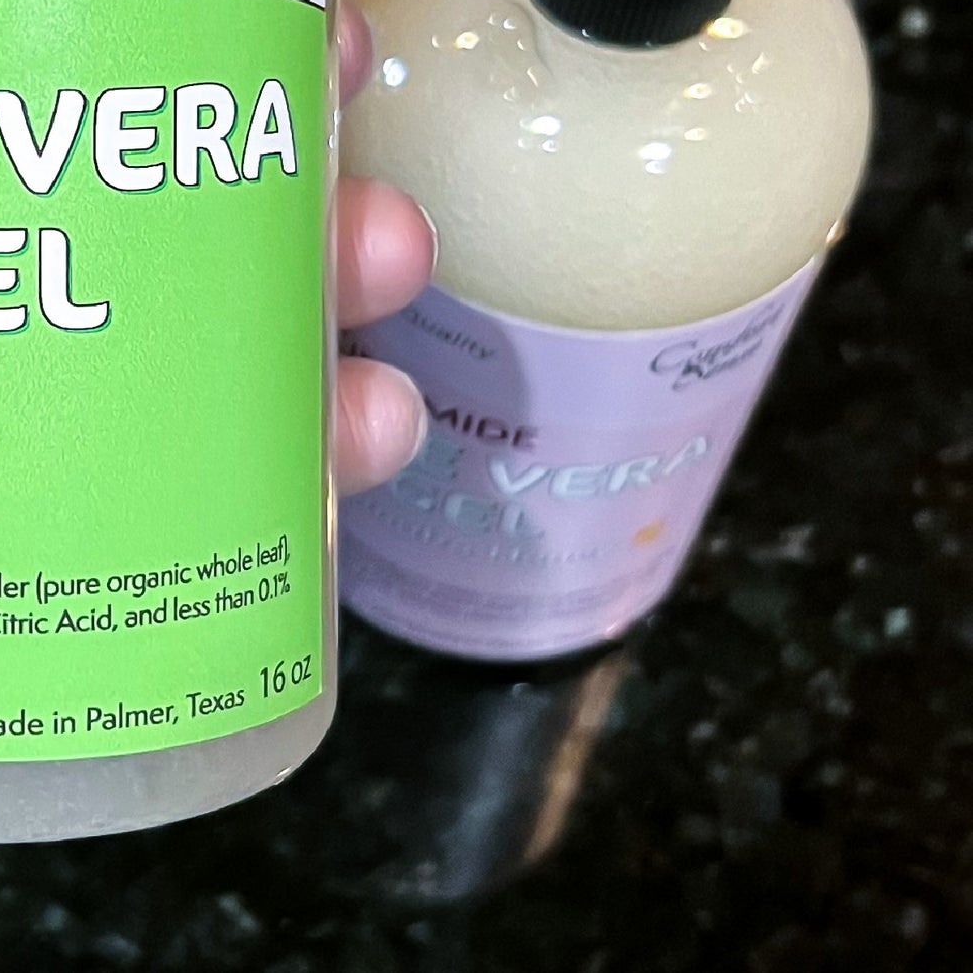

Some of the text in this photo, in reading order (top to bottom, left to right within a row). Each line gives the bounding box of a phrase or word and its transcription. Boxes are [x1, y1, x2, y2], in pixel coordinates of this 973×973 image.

[485, 433, 713, 500] VERA
[35, 571, 101, 604] (pure
[106, 563, 192, 599] organic
[196, 545, 253, 581] whole
[54, 603, 119, 634] Acid,
[124, 597, 167, 627] and
[173, 596, 211, 621] less
[214, 586, 255, 615] than
[258, 571, 291, 603] 0.1%
[53, 710, 77, 735] in
[86, 701, 180, 732] Palmer,
[186, 689, 245, 719] Texas
[259, 660, 287, 698] 16
[290, 654, 313, 685] oz
